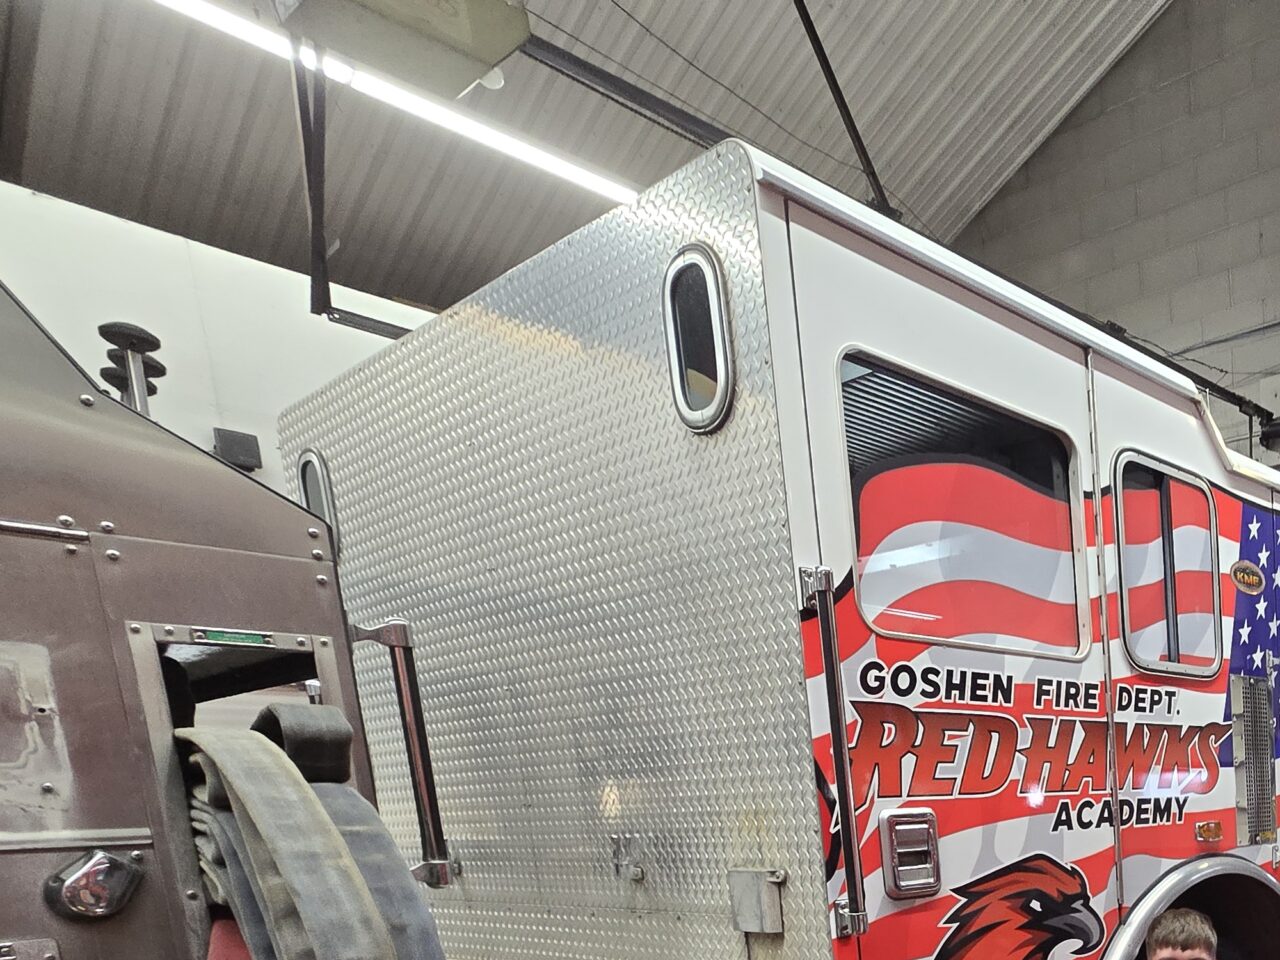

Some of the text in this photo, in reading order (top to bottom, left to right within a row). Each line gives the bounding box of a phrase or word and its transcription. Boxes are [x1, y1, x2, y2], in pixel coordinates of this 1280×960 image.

[1235, 571, 1260, 586] KME
[859, 660, 1180, 715] GOSHEN FIRE DEPT.
[1052, 796, 1190, 832] ACADEMY
